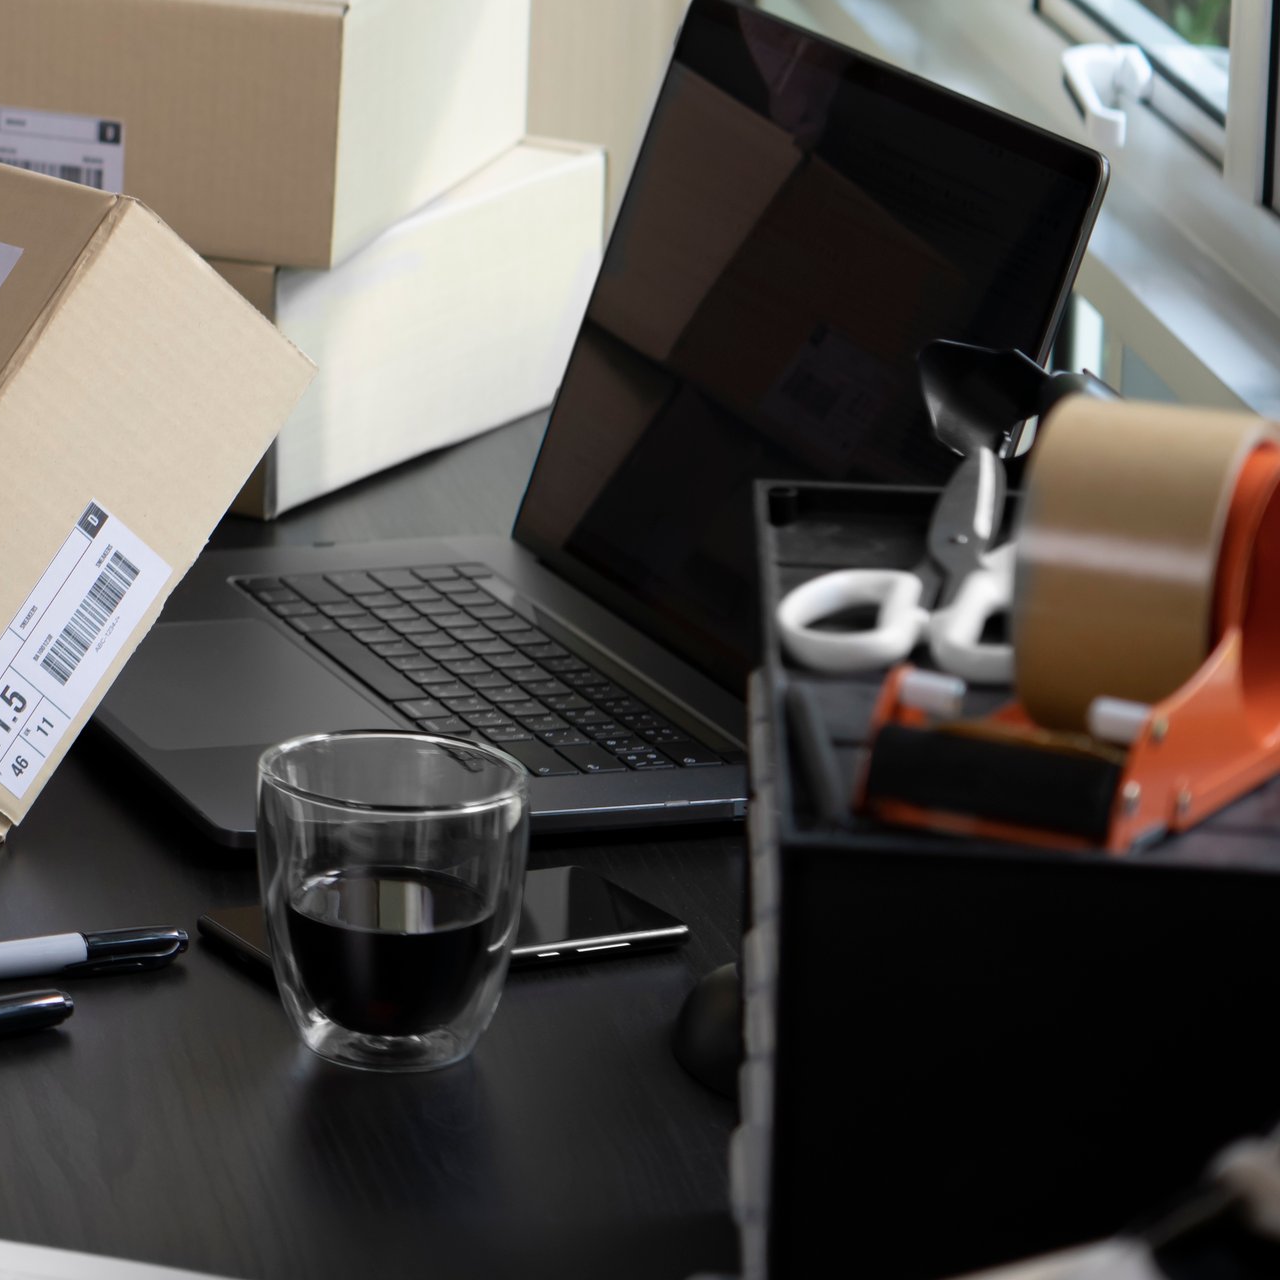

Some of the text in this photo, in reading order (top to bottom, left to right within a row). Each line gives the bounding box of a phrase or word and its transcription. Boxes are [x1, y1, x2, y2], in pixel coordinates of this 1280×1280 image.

[88, 514, 98, 526] D
[96, 544, 112, 567] SNEAKERS
[20, 605, 37, 629] SNEAKERS
[36, 717, 53, 737] 11
[11, 755, 29, 778] 46
